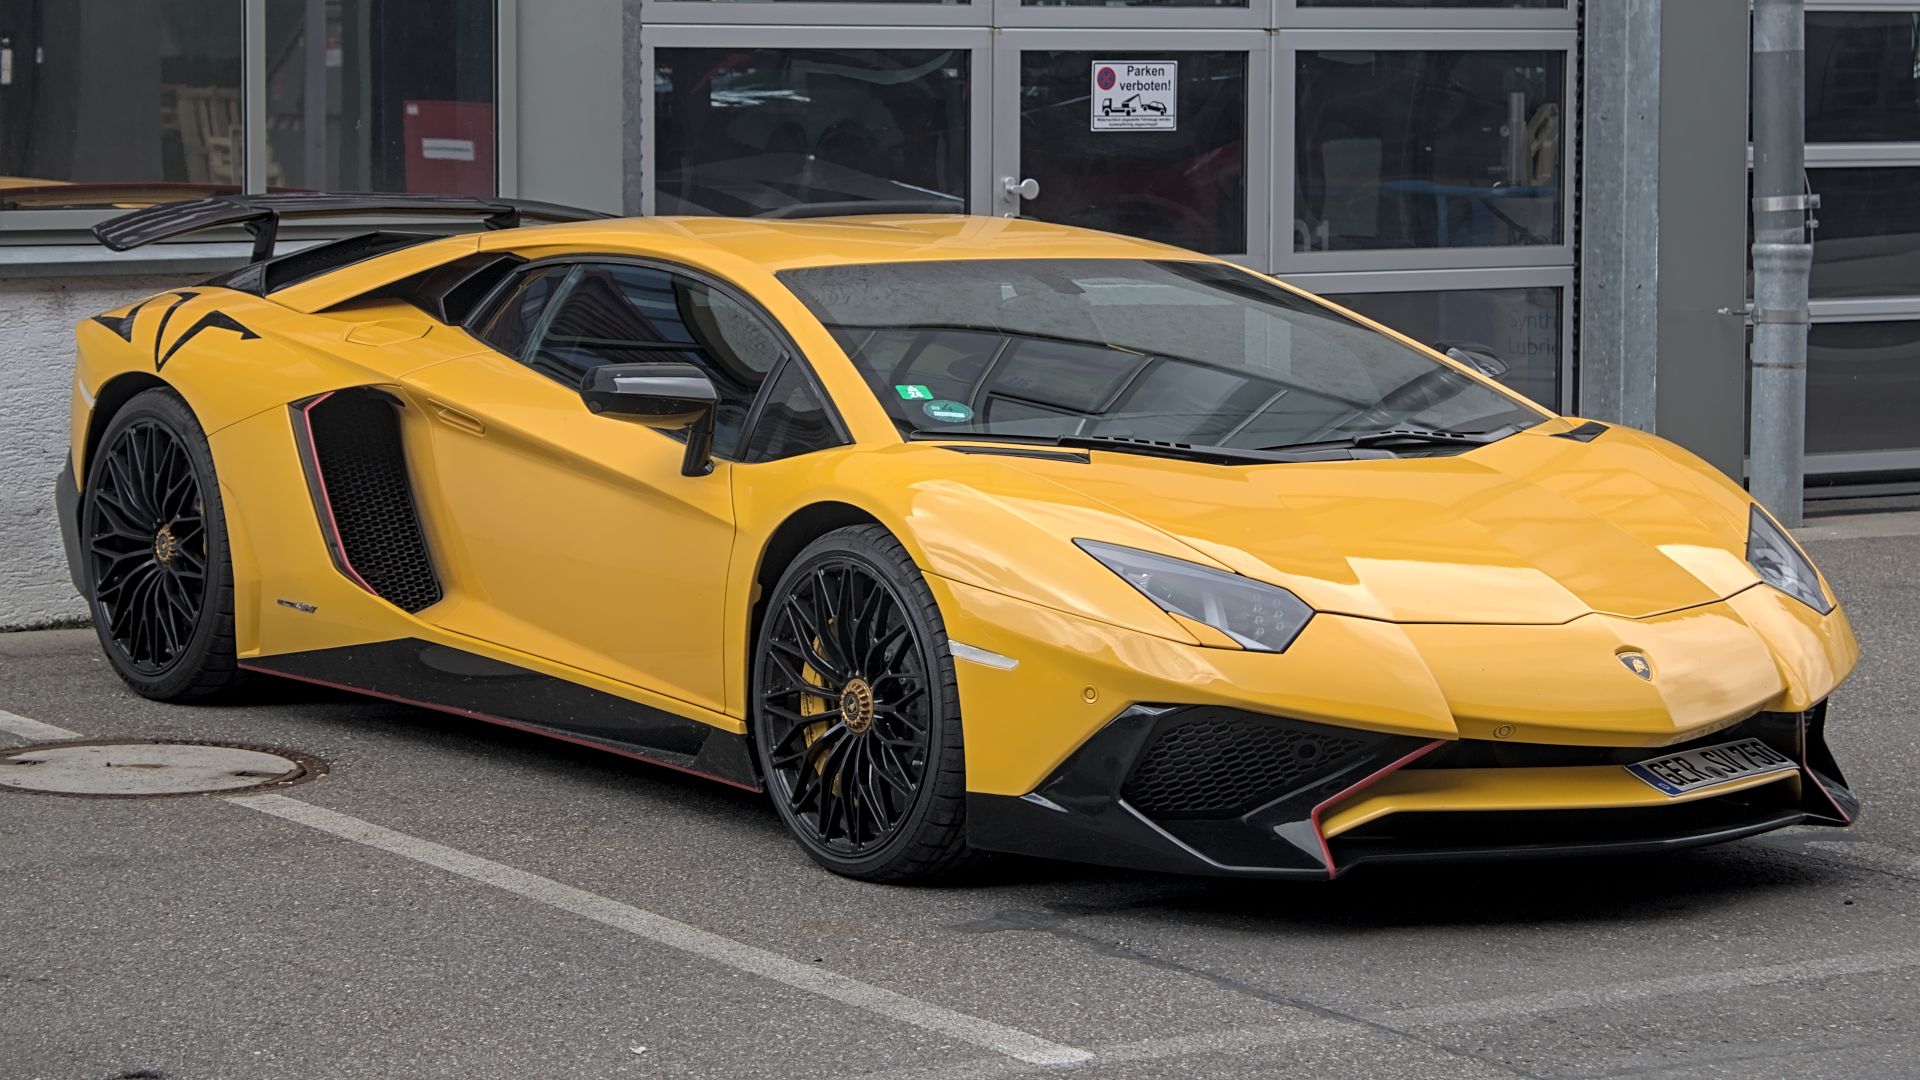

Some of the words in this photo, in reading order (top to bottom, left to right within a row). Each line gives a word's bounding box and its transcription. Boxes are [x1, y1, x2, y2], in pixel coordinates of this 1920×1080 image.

[1127, 65, 1165, 76] Parken
[1119, 80, 1171, 91] verboten!
[1647, 757, 1714, 786] GER
[1700, 748, 1749, 773] SV
